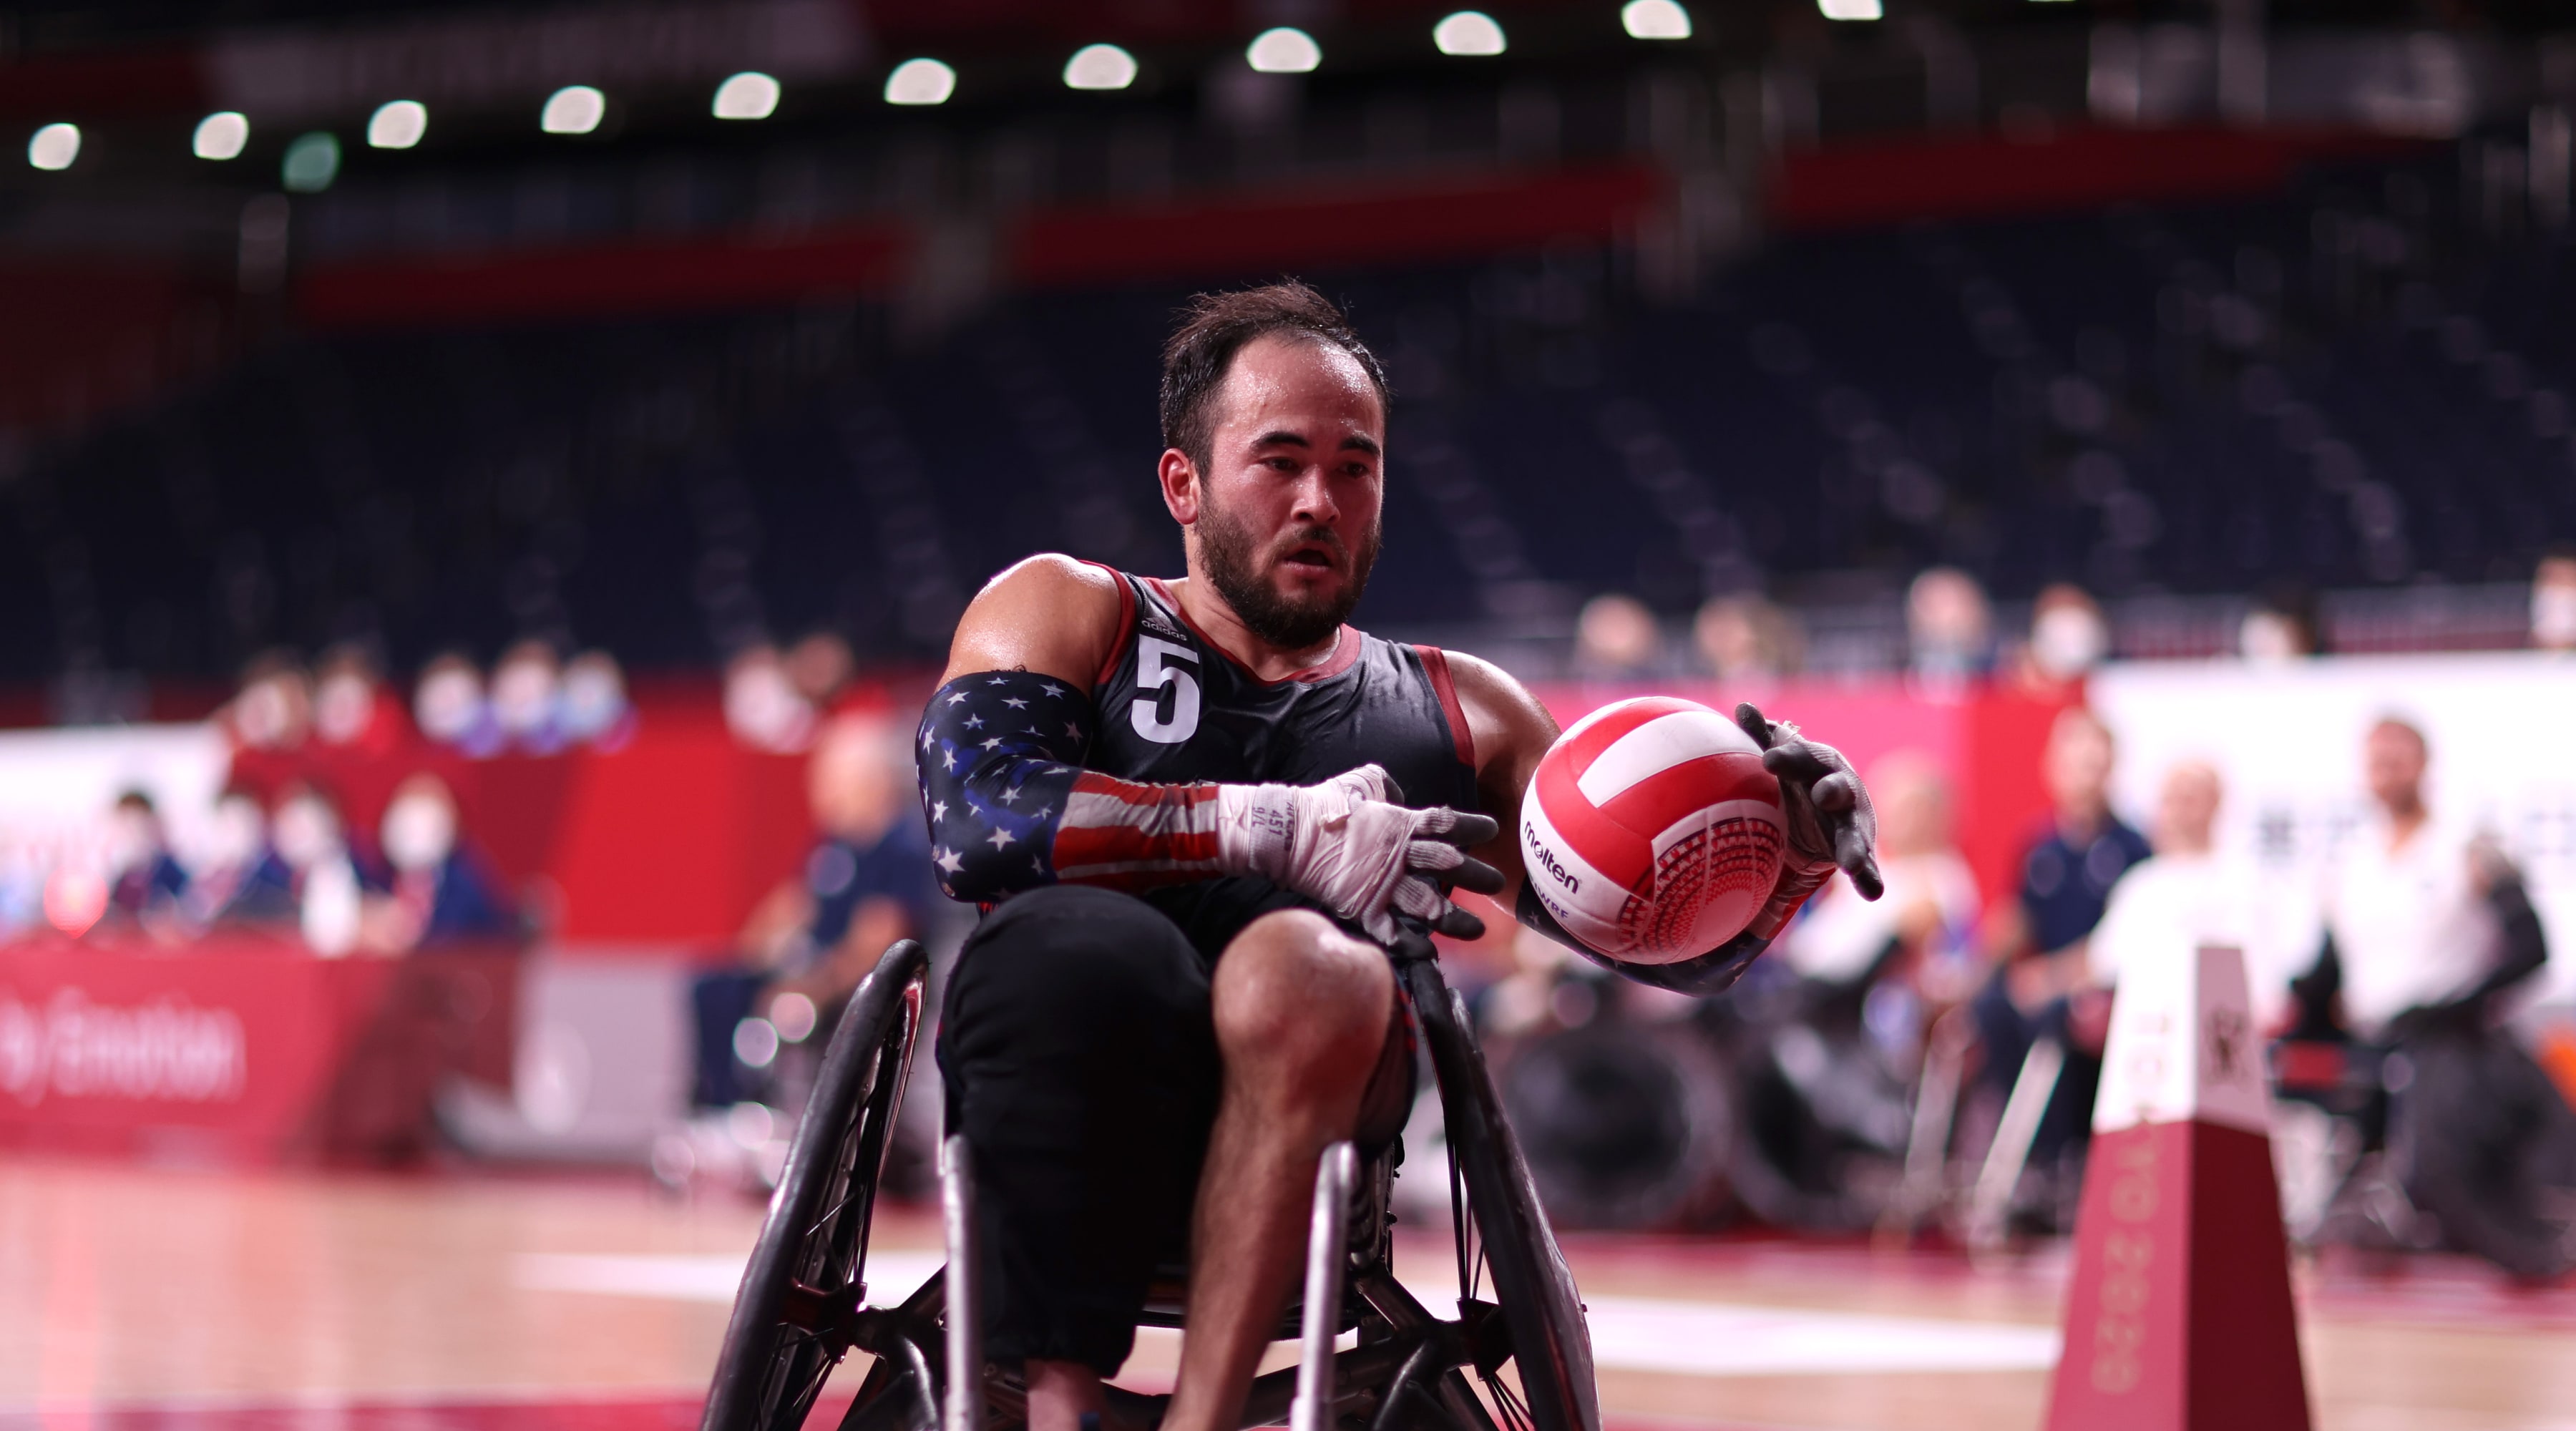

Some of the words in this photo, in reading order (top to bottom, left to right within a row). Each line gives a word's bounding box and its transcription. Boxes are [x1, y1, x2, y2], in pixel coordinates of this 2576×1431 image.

[1141, 619, 1188, 642] adidas
[1131, 633, 1200, 744] 5
[1269, 810, 1284, 836] 451
[1524, 820, 1579, 894] molten
